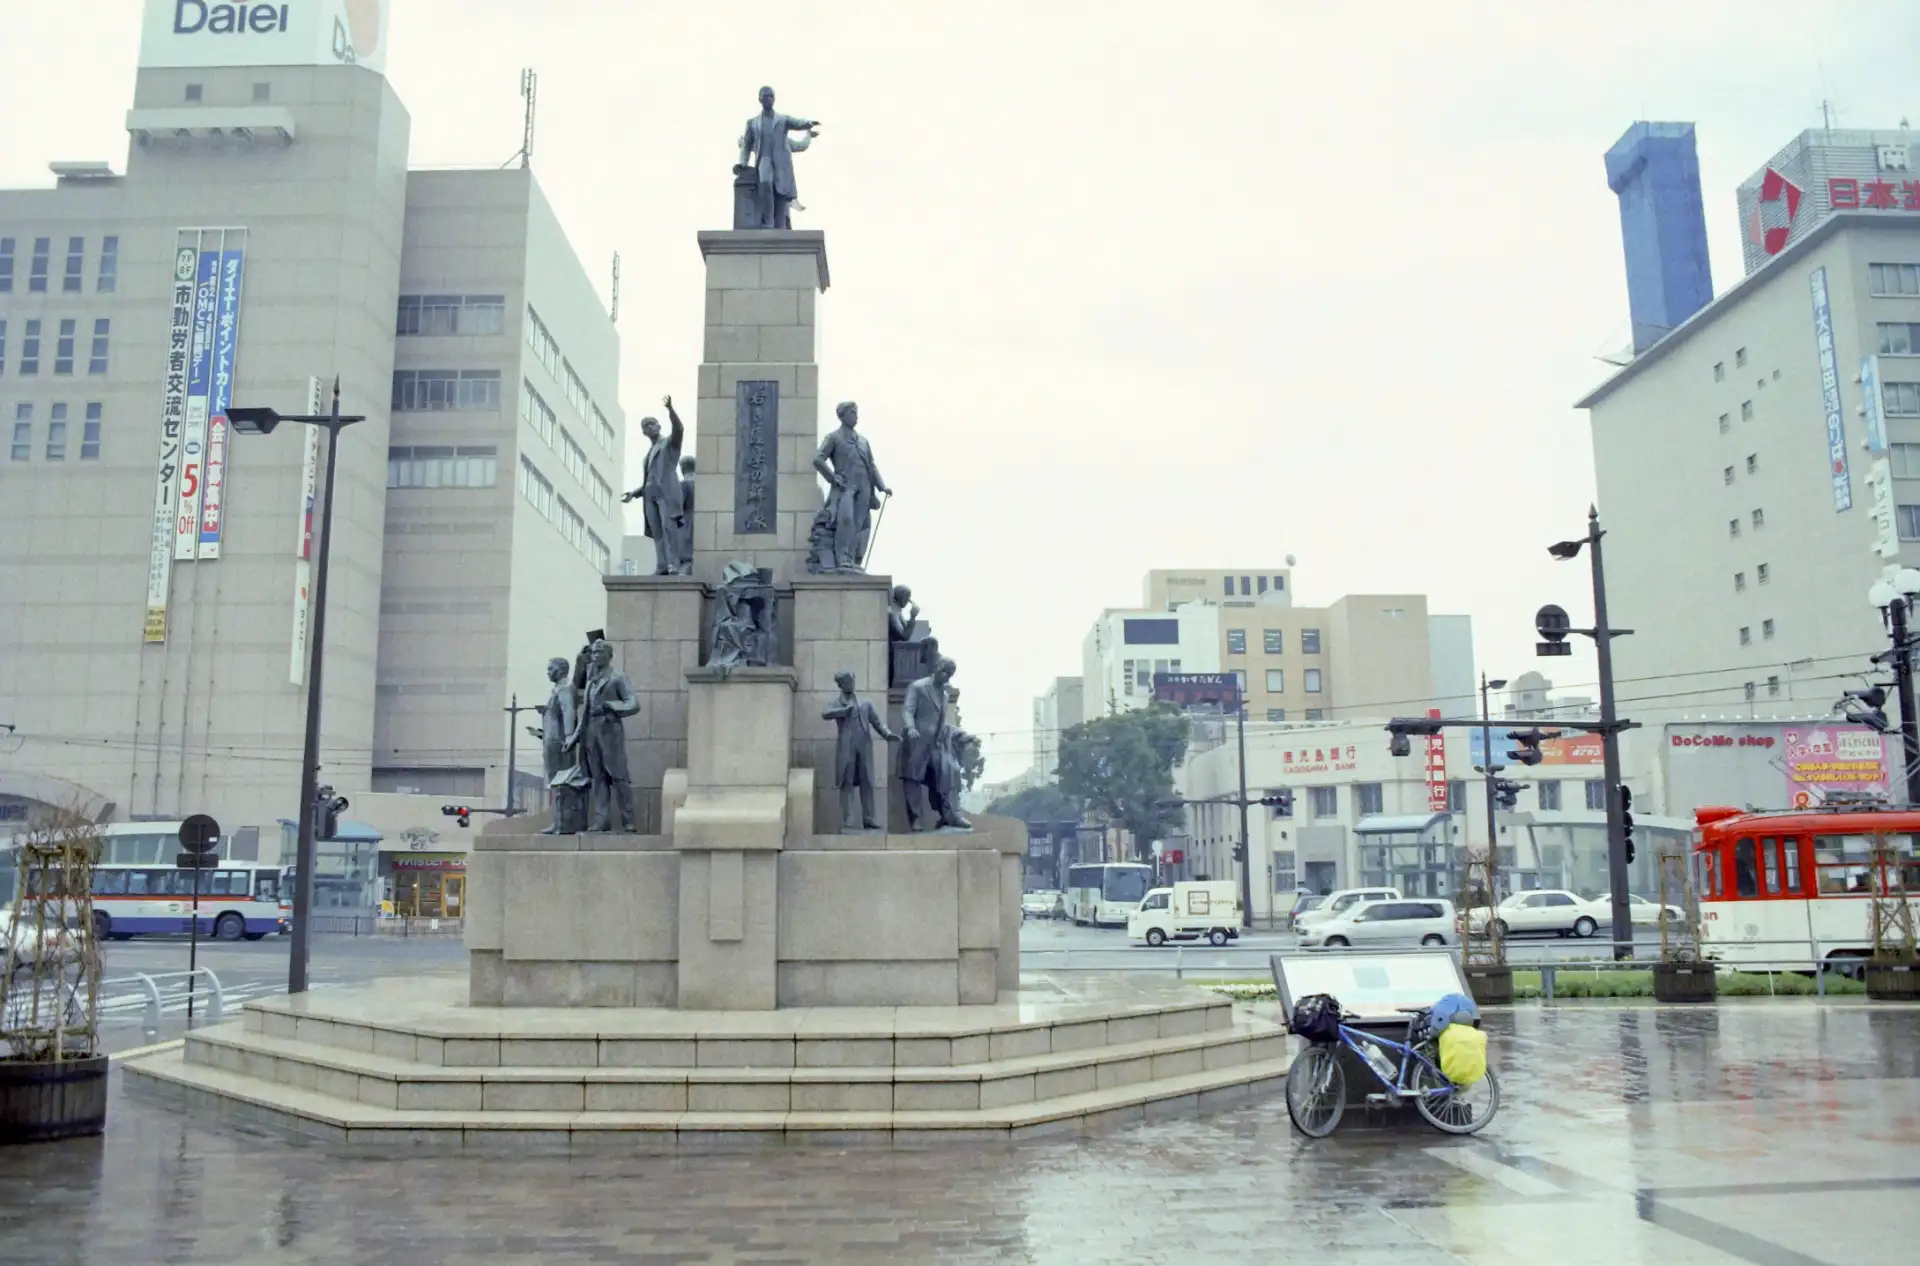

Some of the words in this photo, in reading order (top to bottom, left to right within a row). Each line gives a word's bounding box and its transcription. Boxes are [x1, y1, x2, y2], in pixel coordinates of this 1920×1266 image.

[173, 0, 289, 33] Daiei
[1671, 734, 1734, 747] DoCoMo
[1738, 733, 1776, 749] shop
[1335, 762, 1357, 771] BANK
